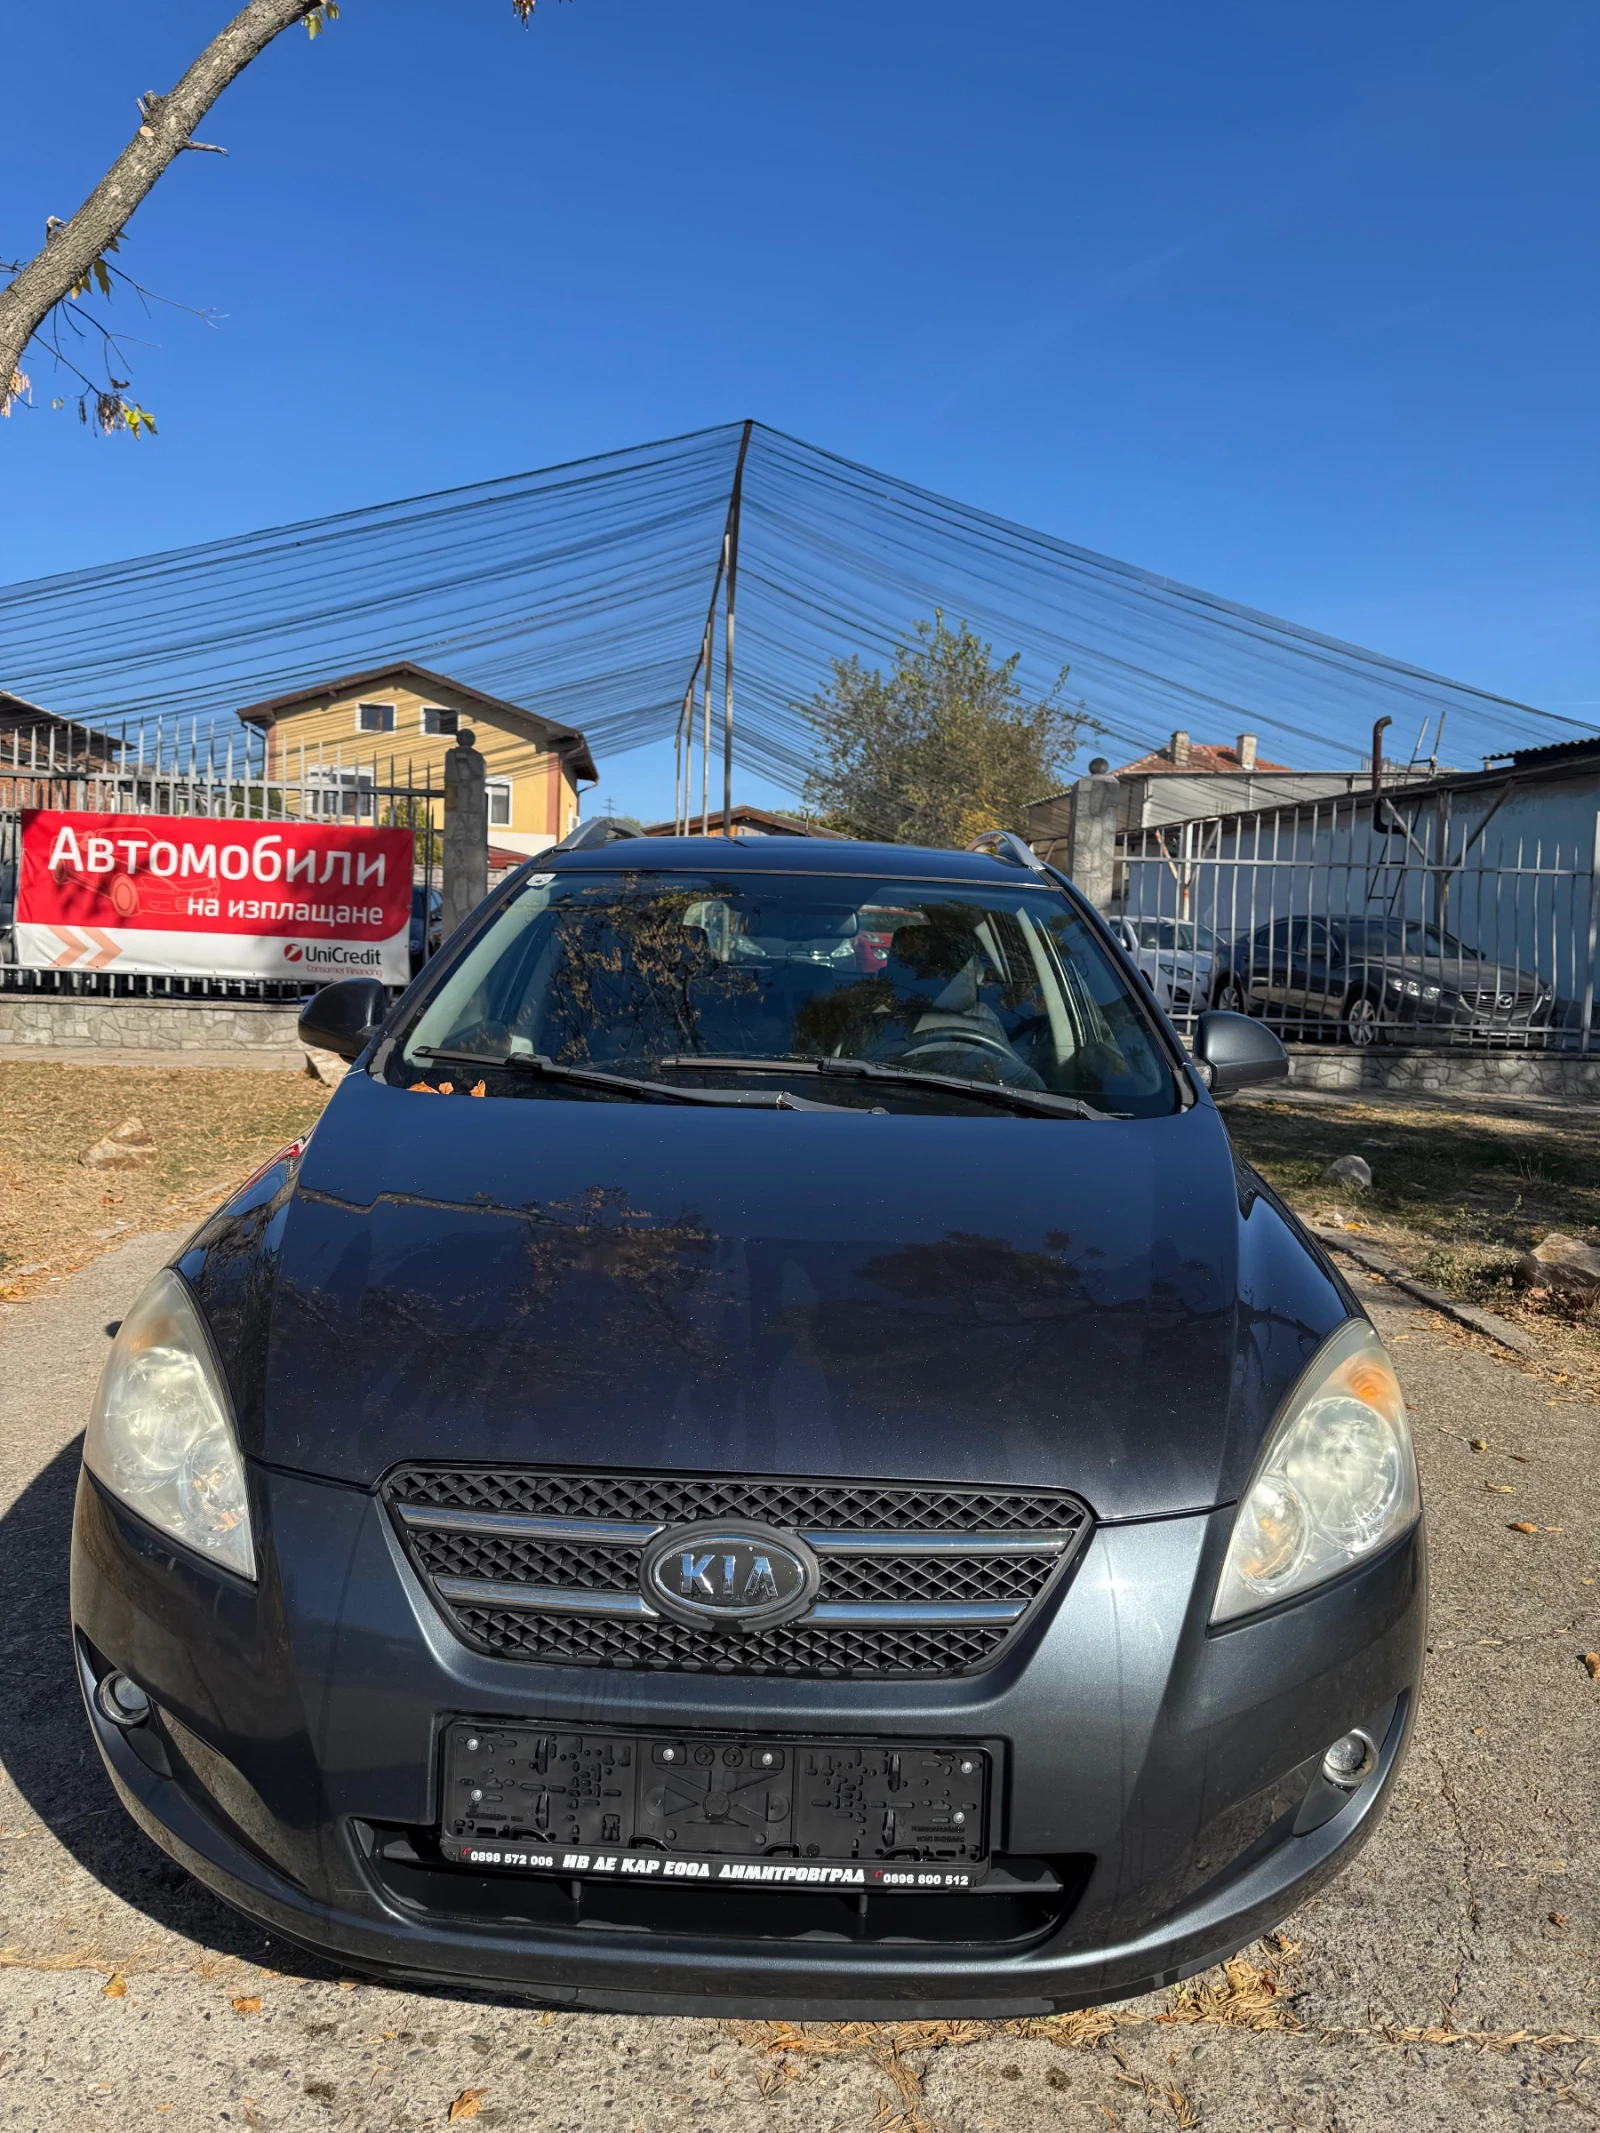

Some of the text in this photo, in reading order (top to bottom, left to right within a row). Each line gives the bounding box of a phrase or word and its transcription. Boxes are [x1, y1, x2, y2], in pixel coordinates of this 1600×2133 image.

[48, 826, 386, 887] Автомобили
[187, 897, 384, 927] на изплащане
[305, 945, 382, 966] UniCredit
[680, 1553, 779, 1597] KIA
[470, 1850, 501, 1863] 0898
[504, 1853, 528, 1865] 572
[562, 1854, 590, 1869] ИВ
[620, 1857, 660, 1873] КАР
[663, 1860, 710, 1877] ЕООД
[718, 1864, 865, 1883] ДИМИТРОВГРАД
[883, 1873, 914, 1884] 0896
[918, 1873, 942, 1885] 800
[945, 1875, 969, 1886] 512
